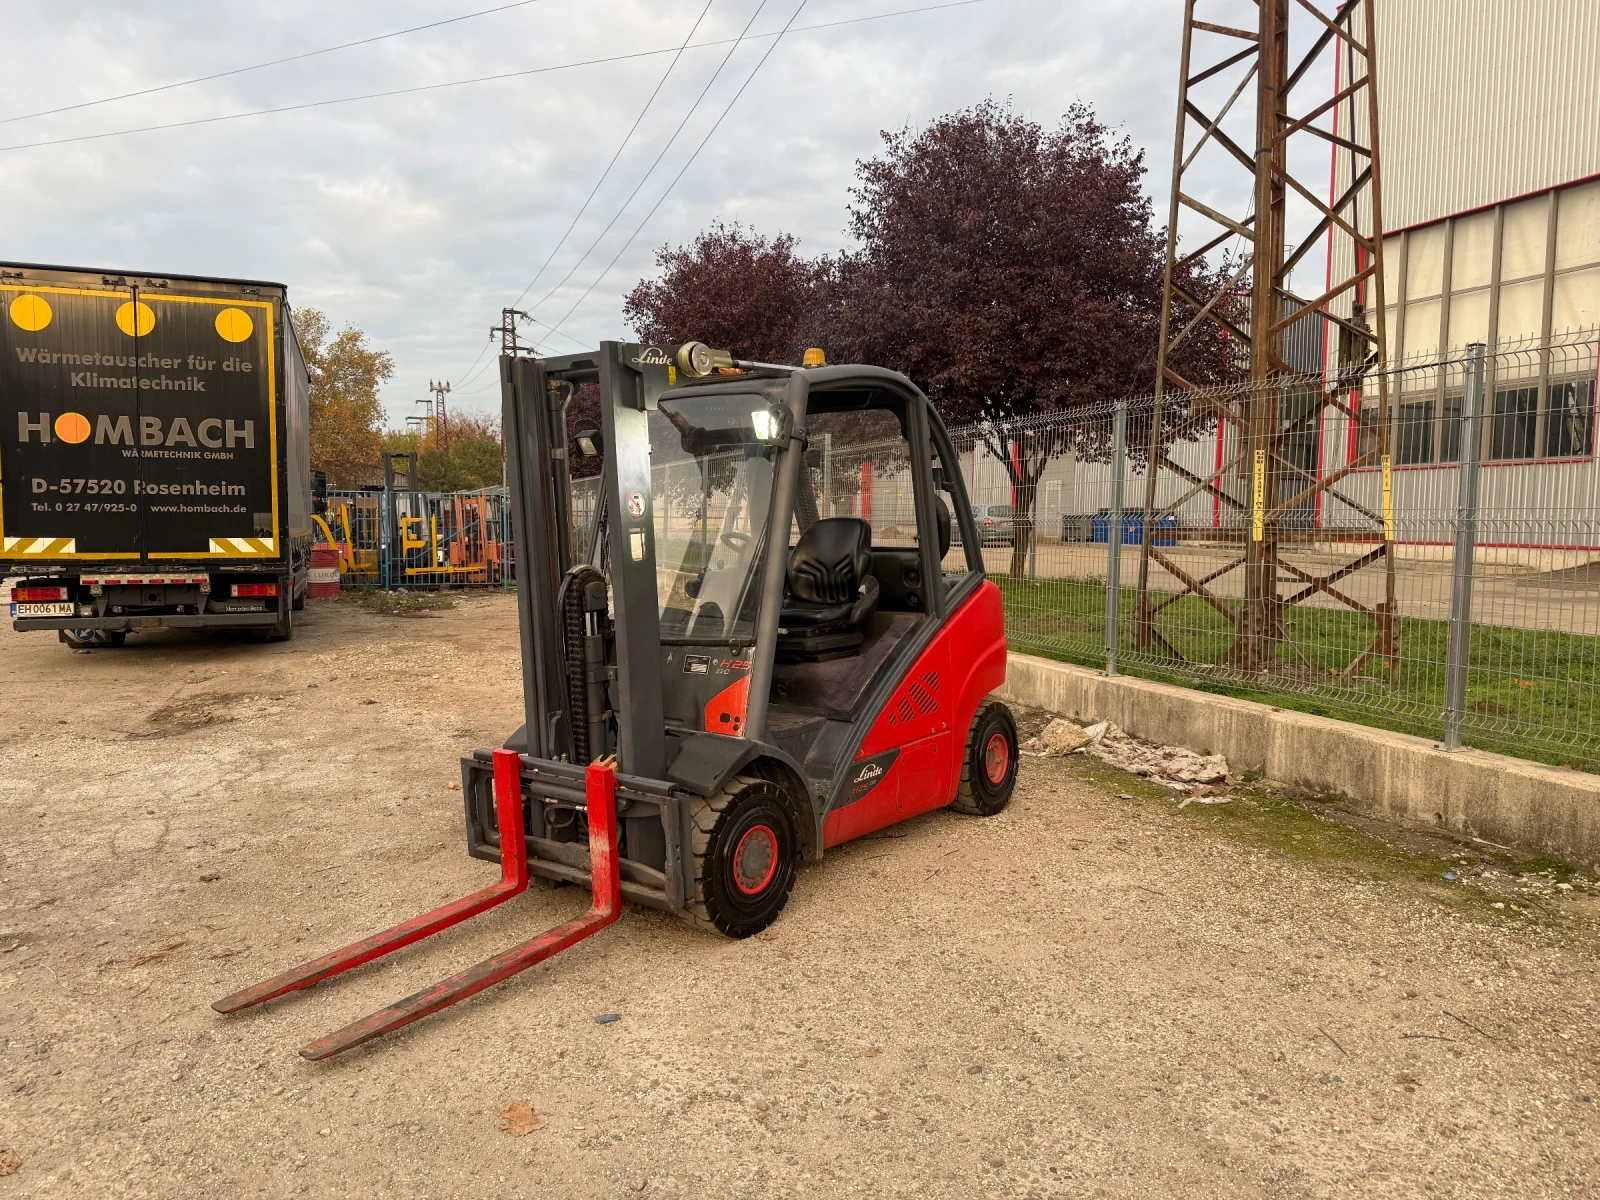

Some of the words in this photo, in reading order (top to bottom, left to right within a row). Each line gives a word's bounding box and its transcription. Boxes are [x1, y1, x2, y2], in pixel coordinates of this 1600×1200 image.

[15, 347, 182, 369] Wärmetauscher
[187, 354, 216, 371] für
[222, 357, 253, 373] die
[631, 346, 673, 365] Linde
[71, 372, 206, 392] Klimatechnik
[17, 411, 255, 449] HOMBACH
[121, 448, 201, 459] WÄRMETECHNIK
[203, 451, 234, 460] GMBH
[31, 478, 126, 494] D-57520
[133, 479, 246, 496] Rosenheim
[31, 502, 52, 512] Tel.
[55, 503, 62, 512] 0
[66, 503, 81, 512] 27
[84, 503, 137, 513] 47/925-0
[150, 503, 247, 513] www.hombach.de
[18, 604, 32, 614] EH
[33, 604, 57, 613] 0061
[58, 604, 72, 613] MA
[853, 763, 883, 783] Linde
